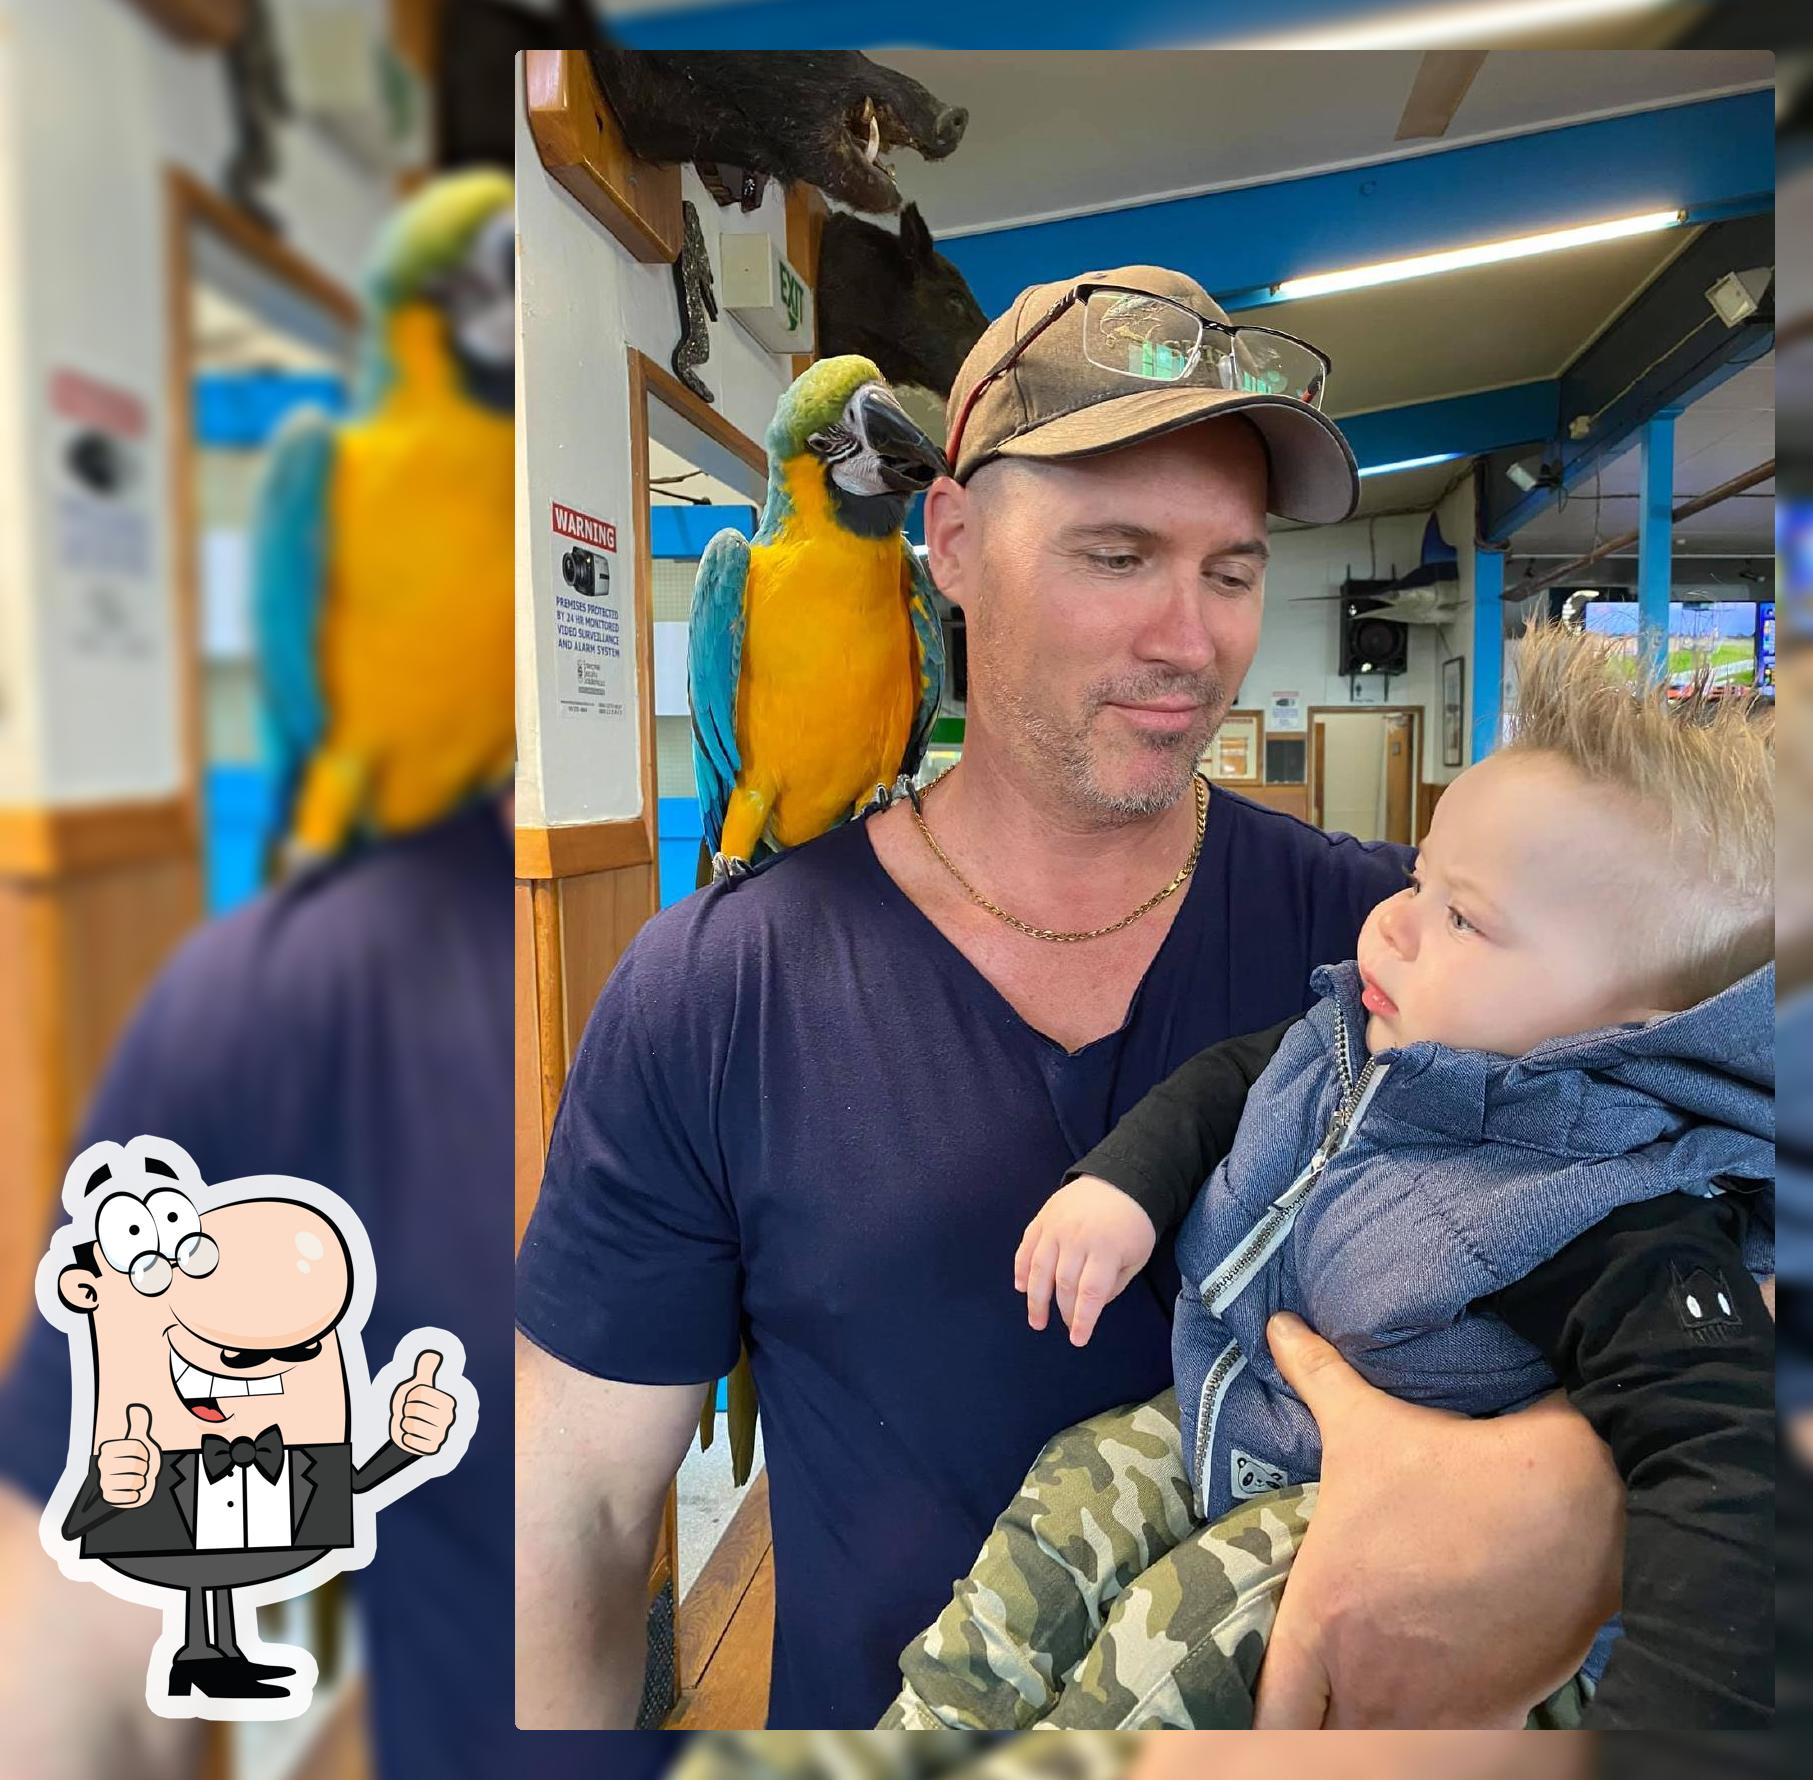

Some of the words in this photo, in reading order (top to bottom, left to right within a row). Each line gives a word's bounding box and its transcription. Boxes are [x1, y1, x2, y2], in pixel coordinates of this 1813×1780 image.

[779, 261, 804, 326] EXIT
[555, 507, 615, 549] WARNING
[556, 596, 587, 613] PREMISES
[587, 603, 619, 620] PROTECTED
[557, 610, 565, 622] BY
[567, 612, 575, 623] 24
[576, 614, 585, 625] HR
[585, 616, 620, 633] MONITORED
[558, 623, 577, 637] VIDEO
[578, 628, 619, 646] SURVEILLANCE
[558, 638, 573, 650] AND
[574, 641, 596, 654] ALARM
[597, 645, 620, 658] SYSTEM
